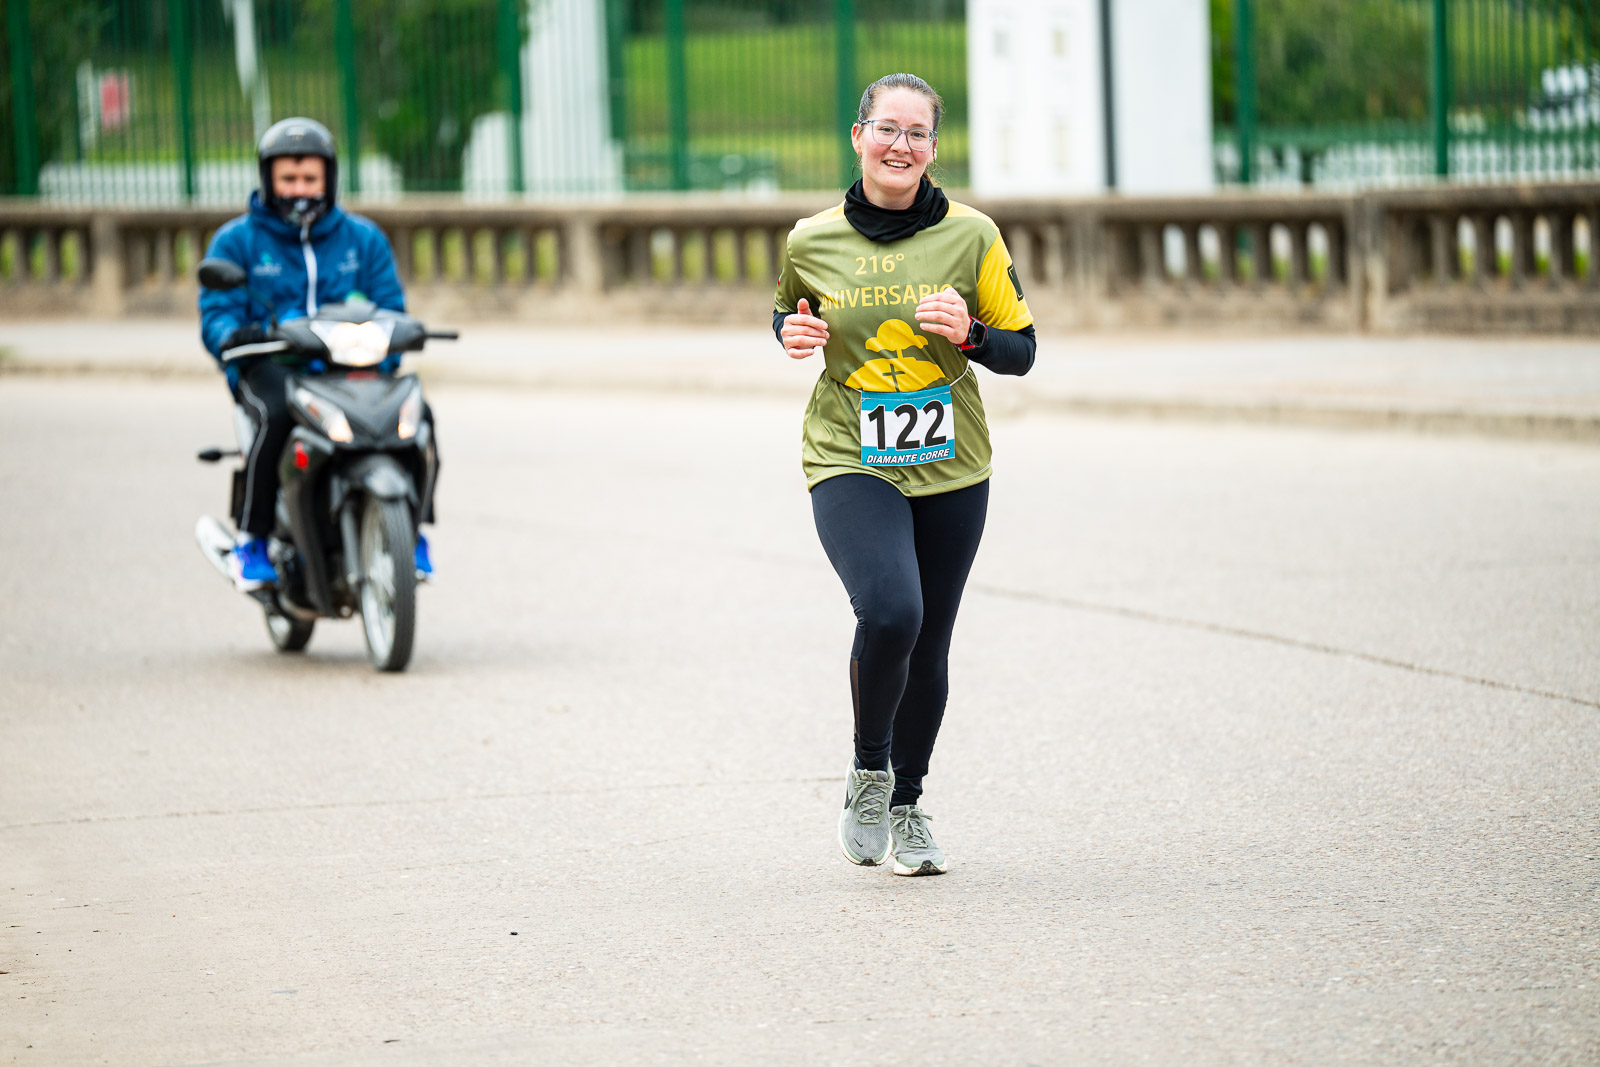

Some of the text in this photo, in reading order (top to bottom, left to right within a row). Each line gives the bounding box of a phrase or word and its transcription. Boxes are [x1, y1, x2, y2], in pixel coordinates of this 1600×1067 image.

[867, 399, 948, 451] 122
[866, 448, 951, 464] DIAMANTE CORRE
